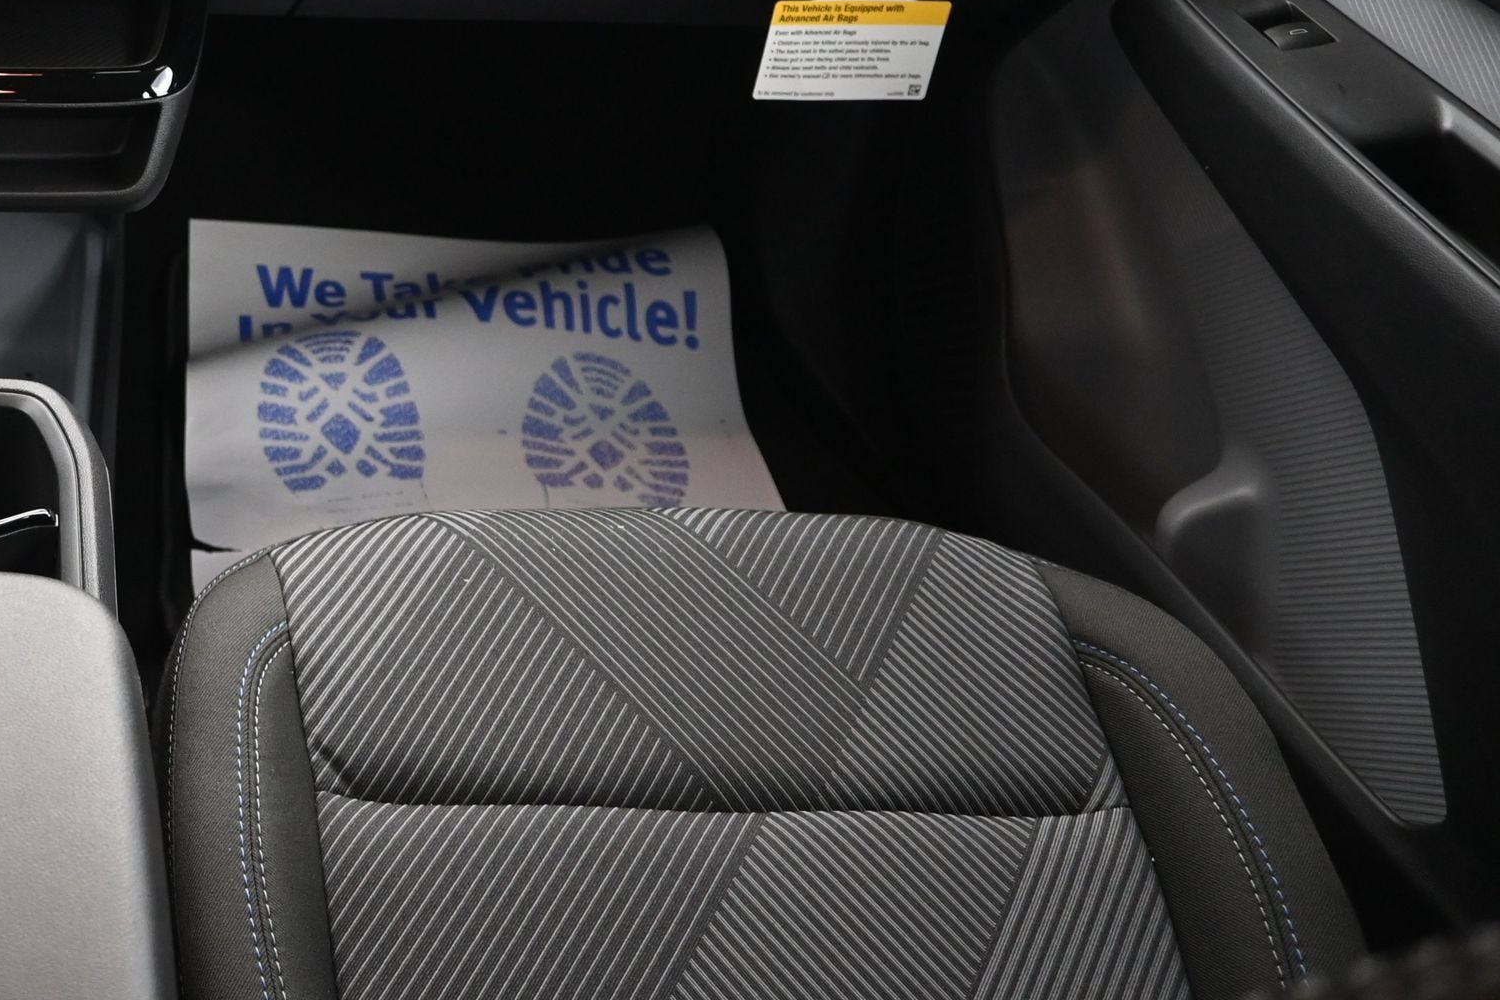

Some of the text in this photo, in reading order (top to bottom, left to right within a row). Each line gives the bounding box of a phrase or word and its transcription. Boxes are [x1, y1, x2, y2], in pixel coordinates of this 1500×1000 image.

[778, 14, 858, 24] Advanced Air Bags
[782, 4, 905, 14] This Vehicle is Equipped with
[257, 265, 347, 308] We
[460, 280, 698, 350] Vehicle!
